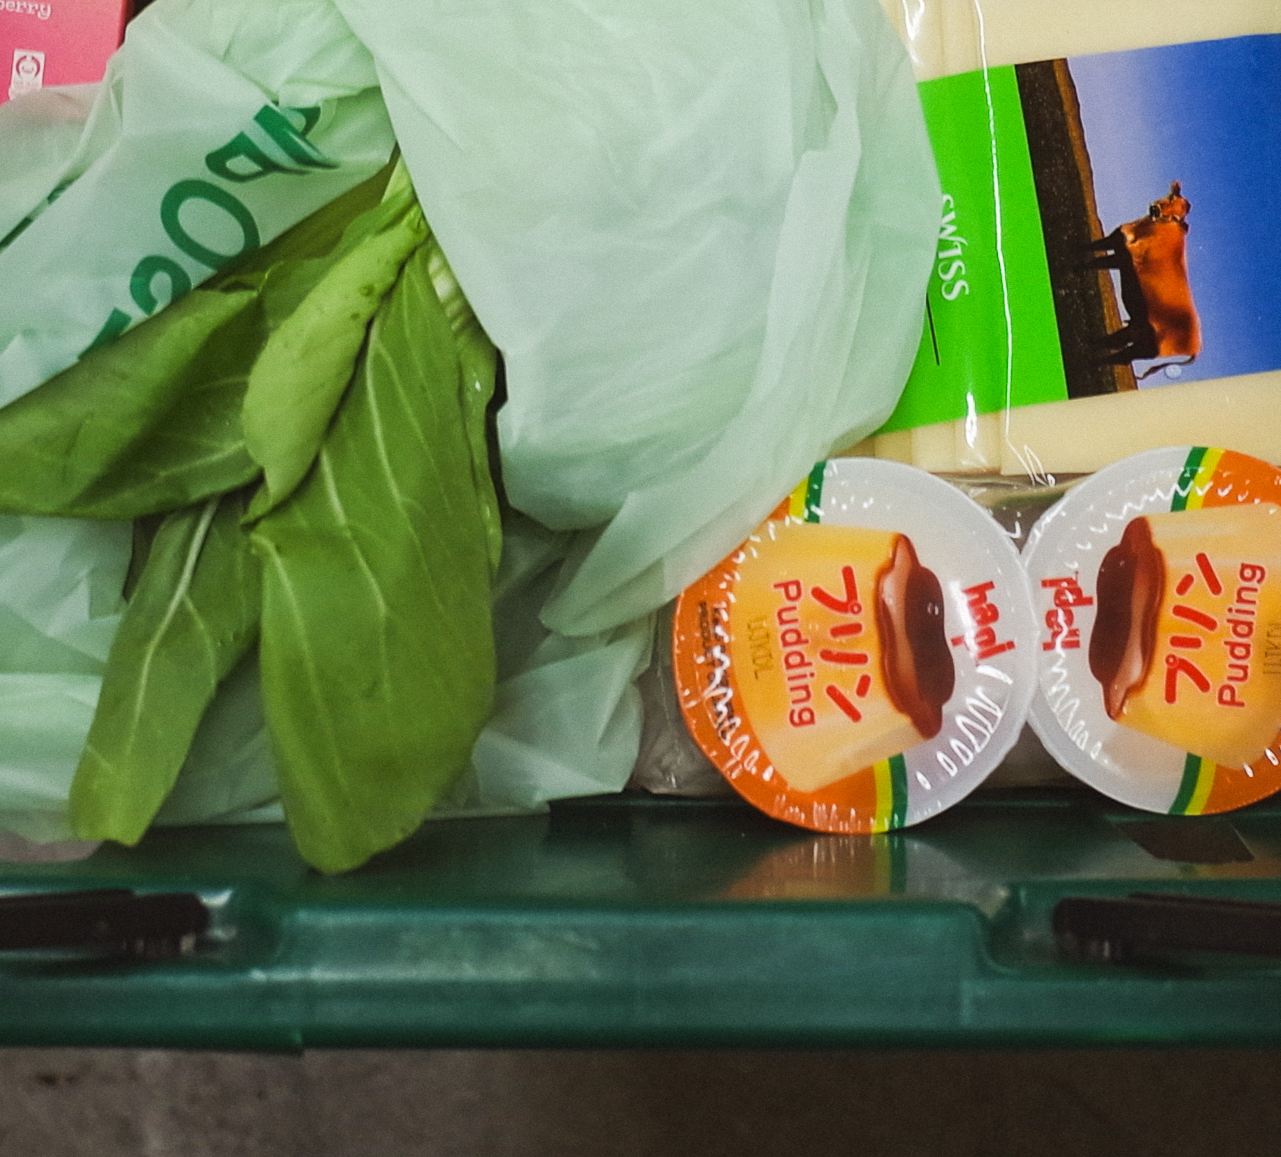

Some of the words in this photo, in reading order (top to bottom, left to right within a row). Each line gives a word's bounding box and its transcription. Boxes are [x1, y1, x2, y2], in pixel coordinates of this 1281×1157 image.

[773, 578, 817, 728] Pudding
[810, 564, 876, 725] プリン
[1163, 552, 1223, 705] プリン
[1217, 562, 1267, 709] Pudding
